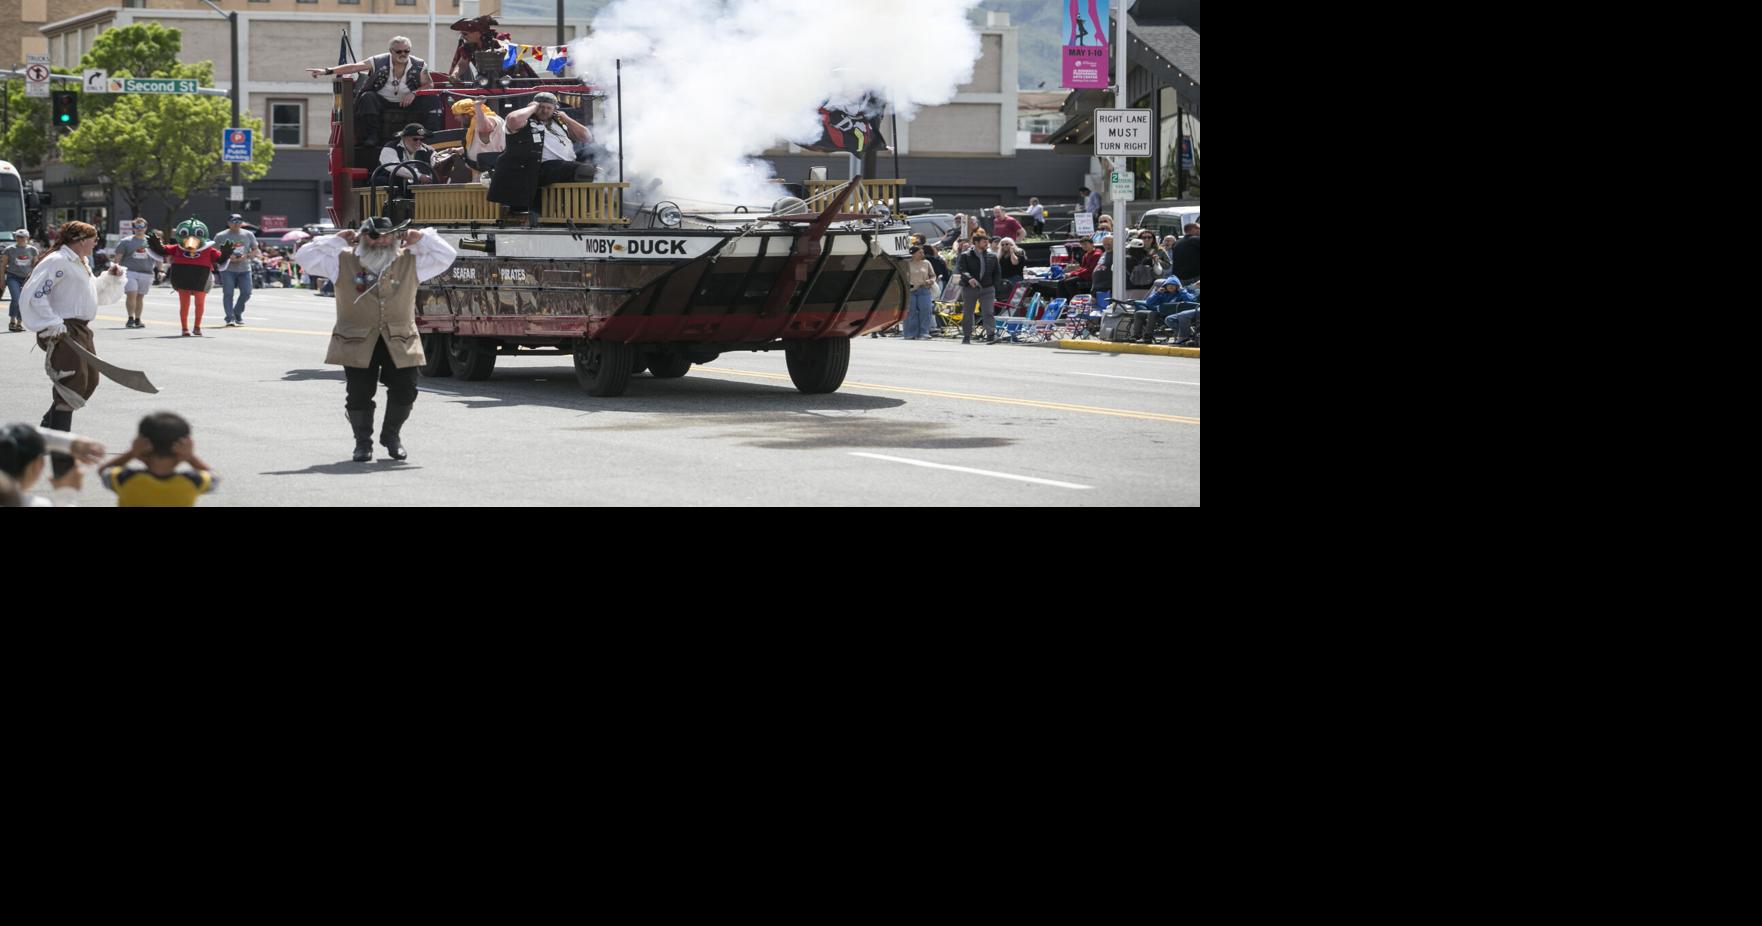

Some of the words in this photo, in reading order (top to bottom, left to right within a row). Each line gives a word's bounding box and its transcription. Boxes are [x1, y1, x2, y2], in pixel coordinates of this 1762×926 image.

[127, 80, 175, 92] Second
[180, 81, 195, 92] St
[1099, 115, 1122, 123] RIGHT
[1126, 115, 1148, 123] LANE
[1108, 128, 1138, 137] MUST
[1100, 142, 1121, 150] TURN
[1124, 142, 1148, 150] RIGHT
[627, 239, 687, 255] DUCK
[453, 267, 476, 279] SEAFAIR
[501, 268, 526, 280] PIRATES
